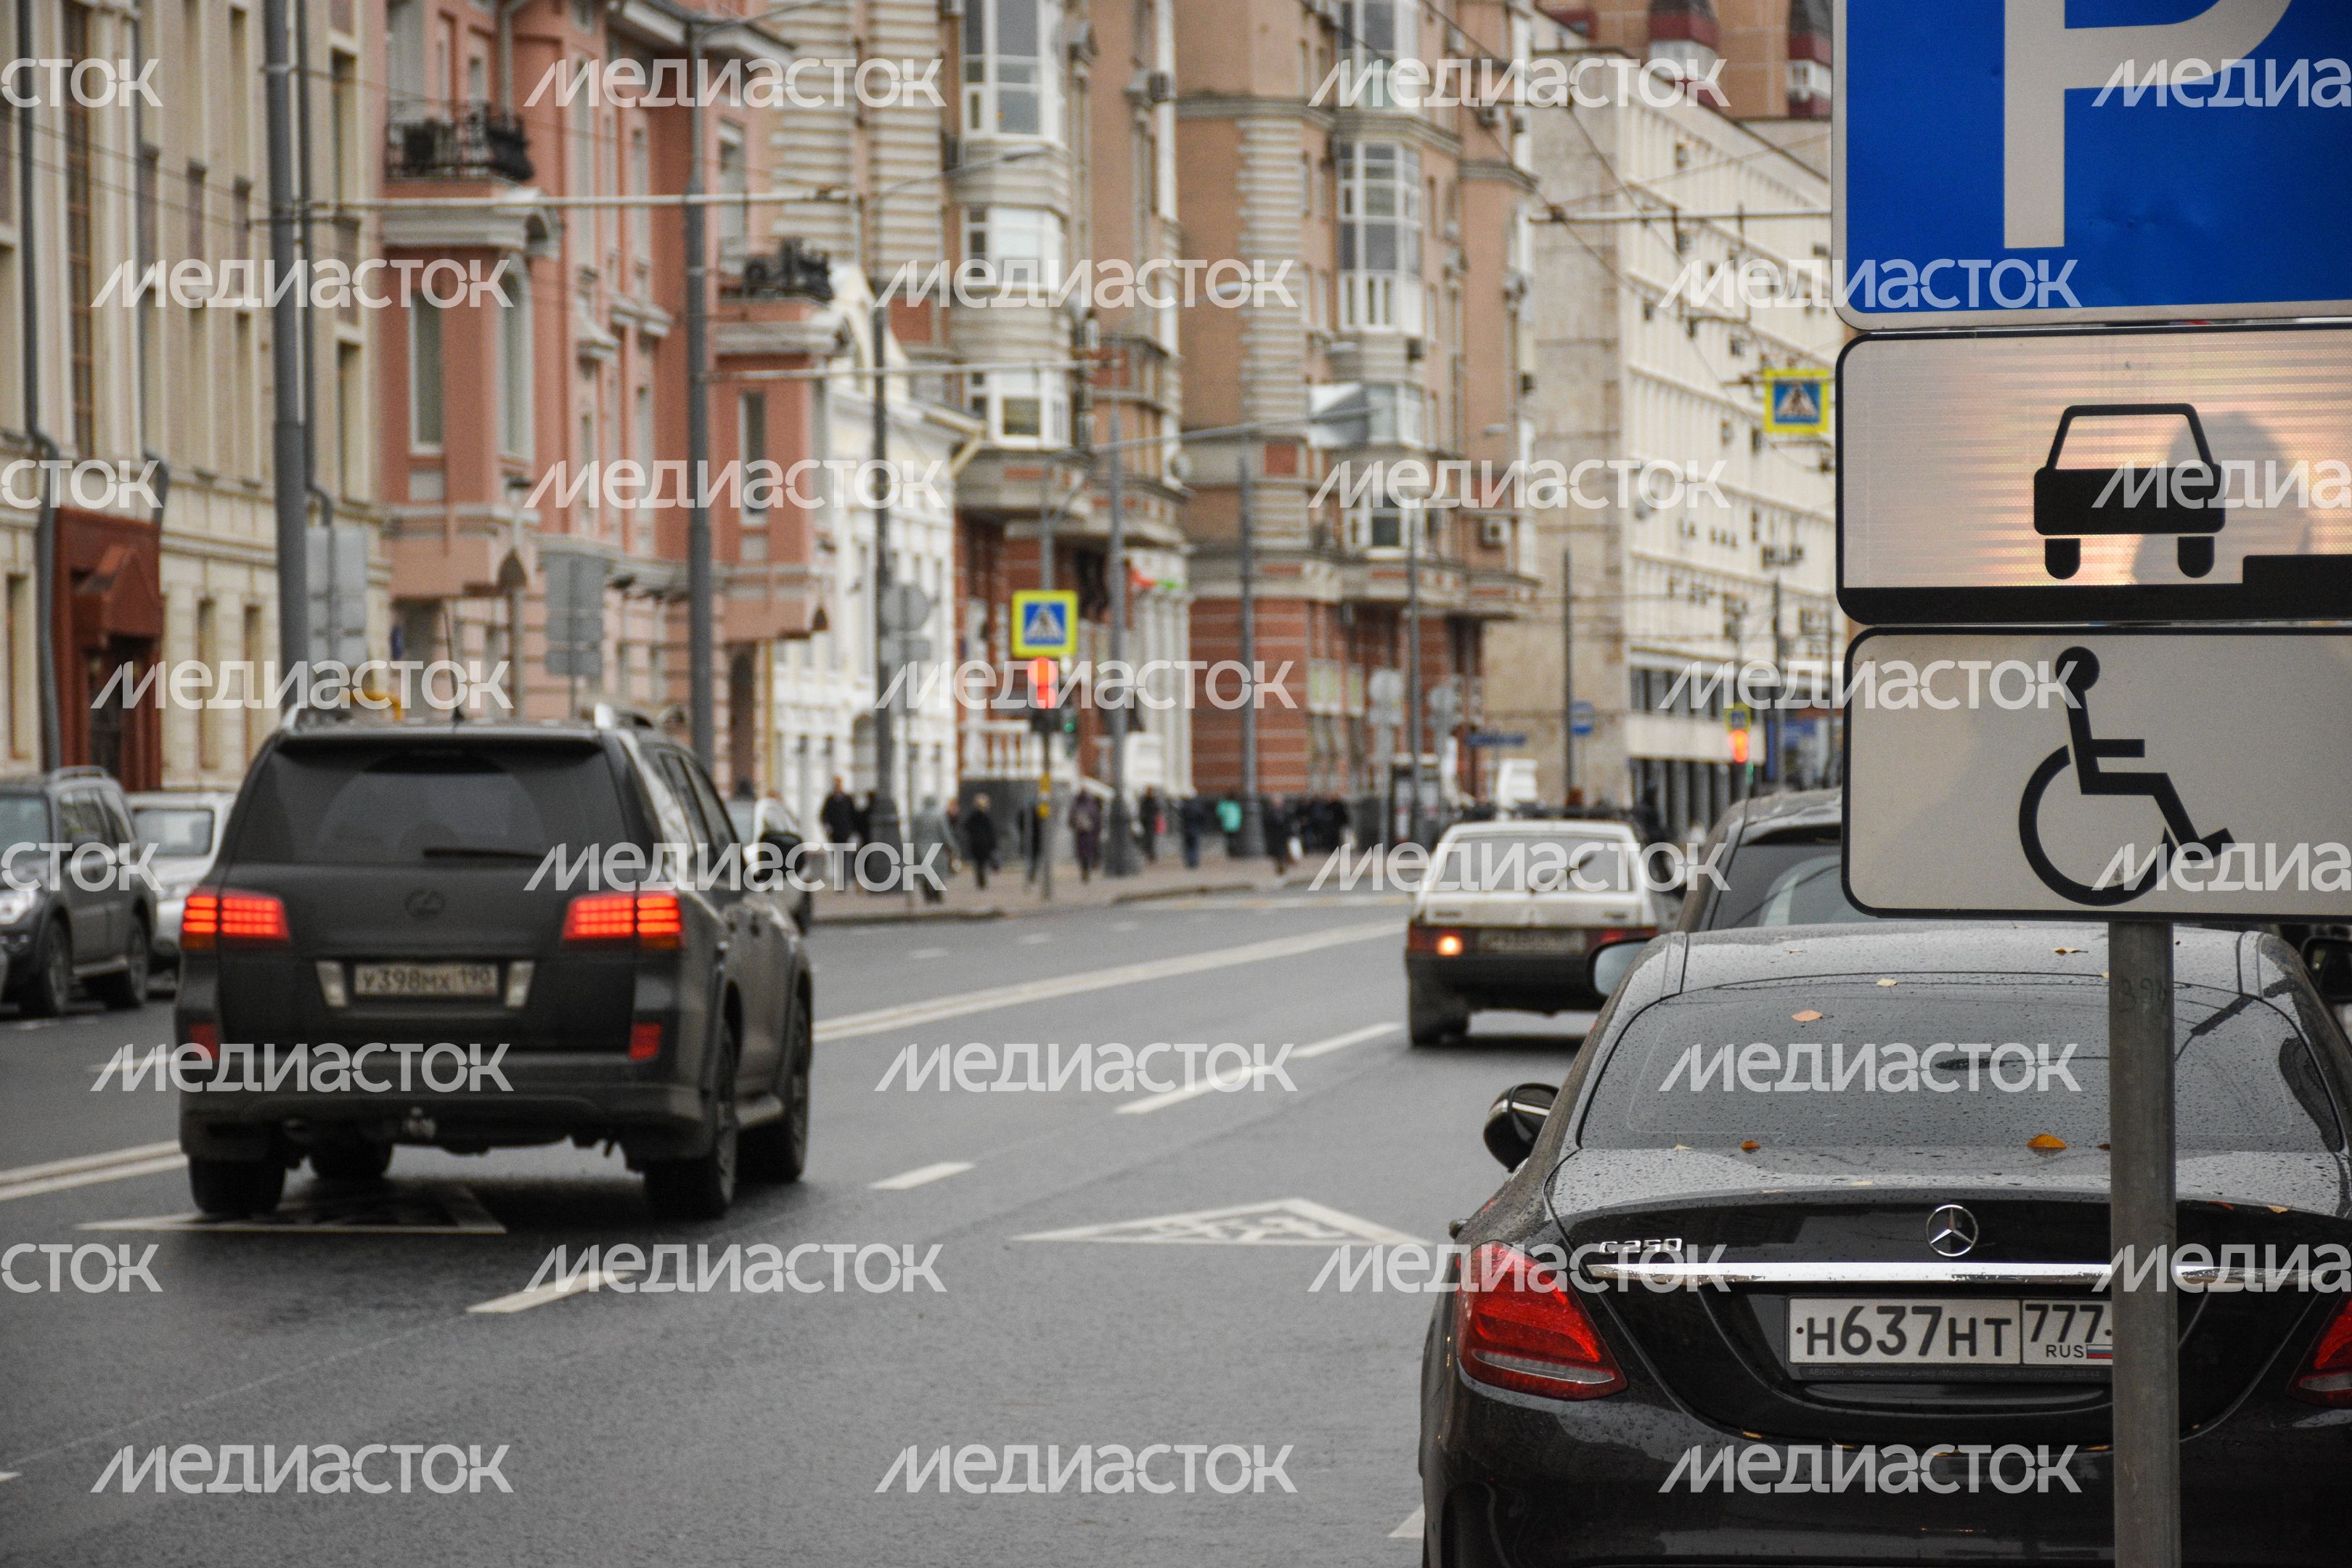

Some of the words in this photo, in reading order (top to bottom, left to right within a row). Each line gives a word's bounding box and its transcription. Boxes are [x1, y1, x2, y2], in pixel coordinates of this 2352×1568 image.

[1599, 1241, 1618, 1254] C
[1622, 1238, 1682, 1254] 250
[1808, 1306, 2012, 1356] Н637НТ
[2025, 1303, 2103, 1343] 777
[2046, 1344, 2083, 1357] RUS
[1808, 1368, 1845, 1376] АВИЛОН
